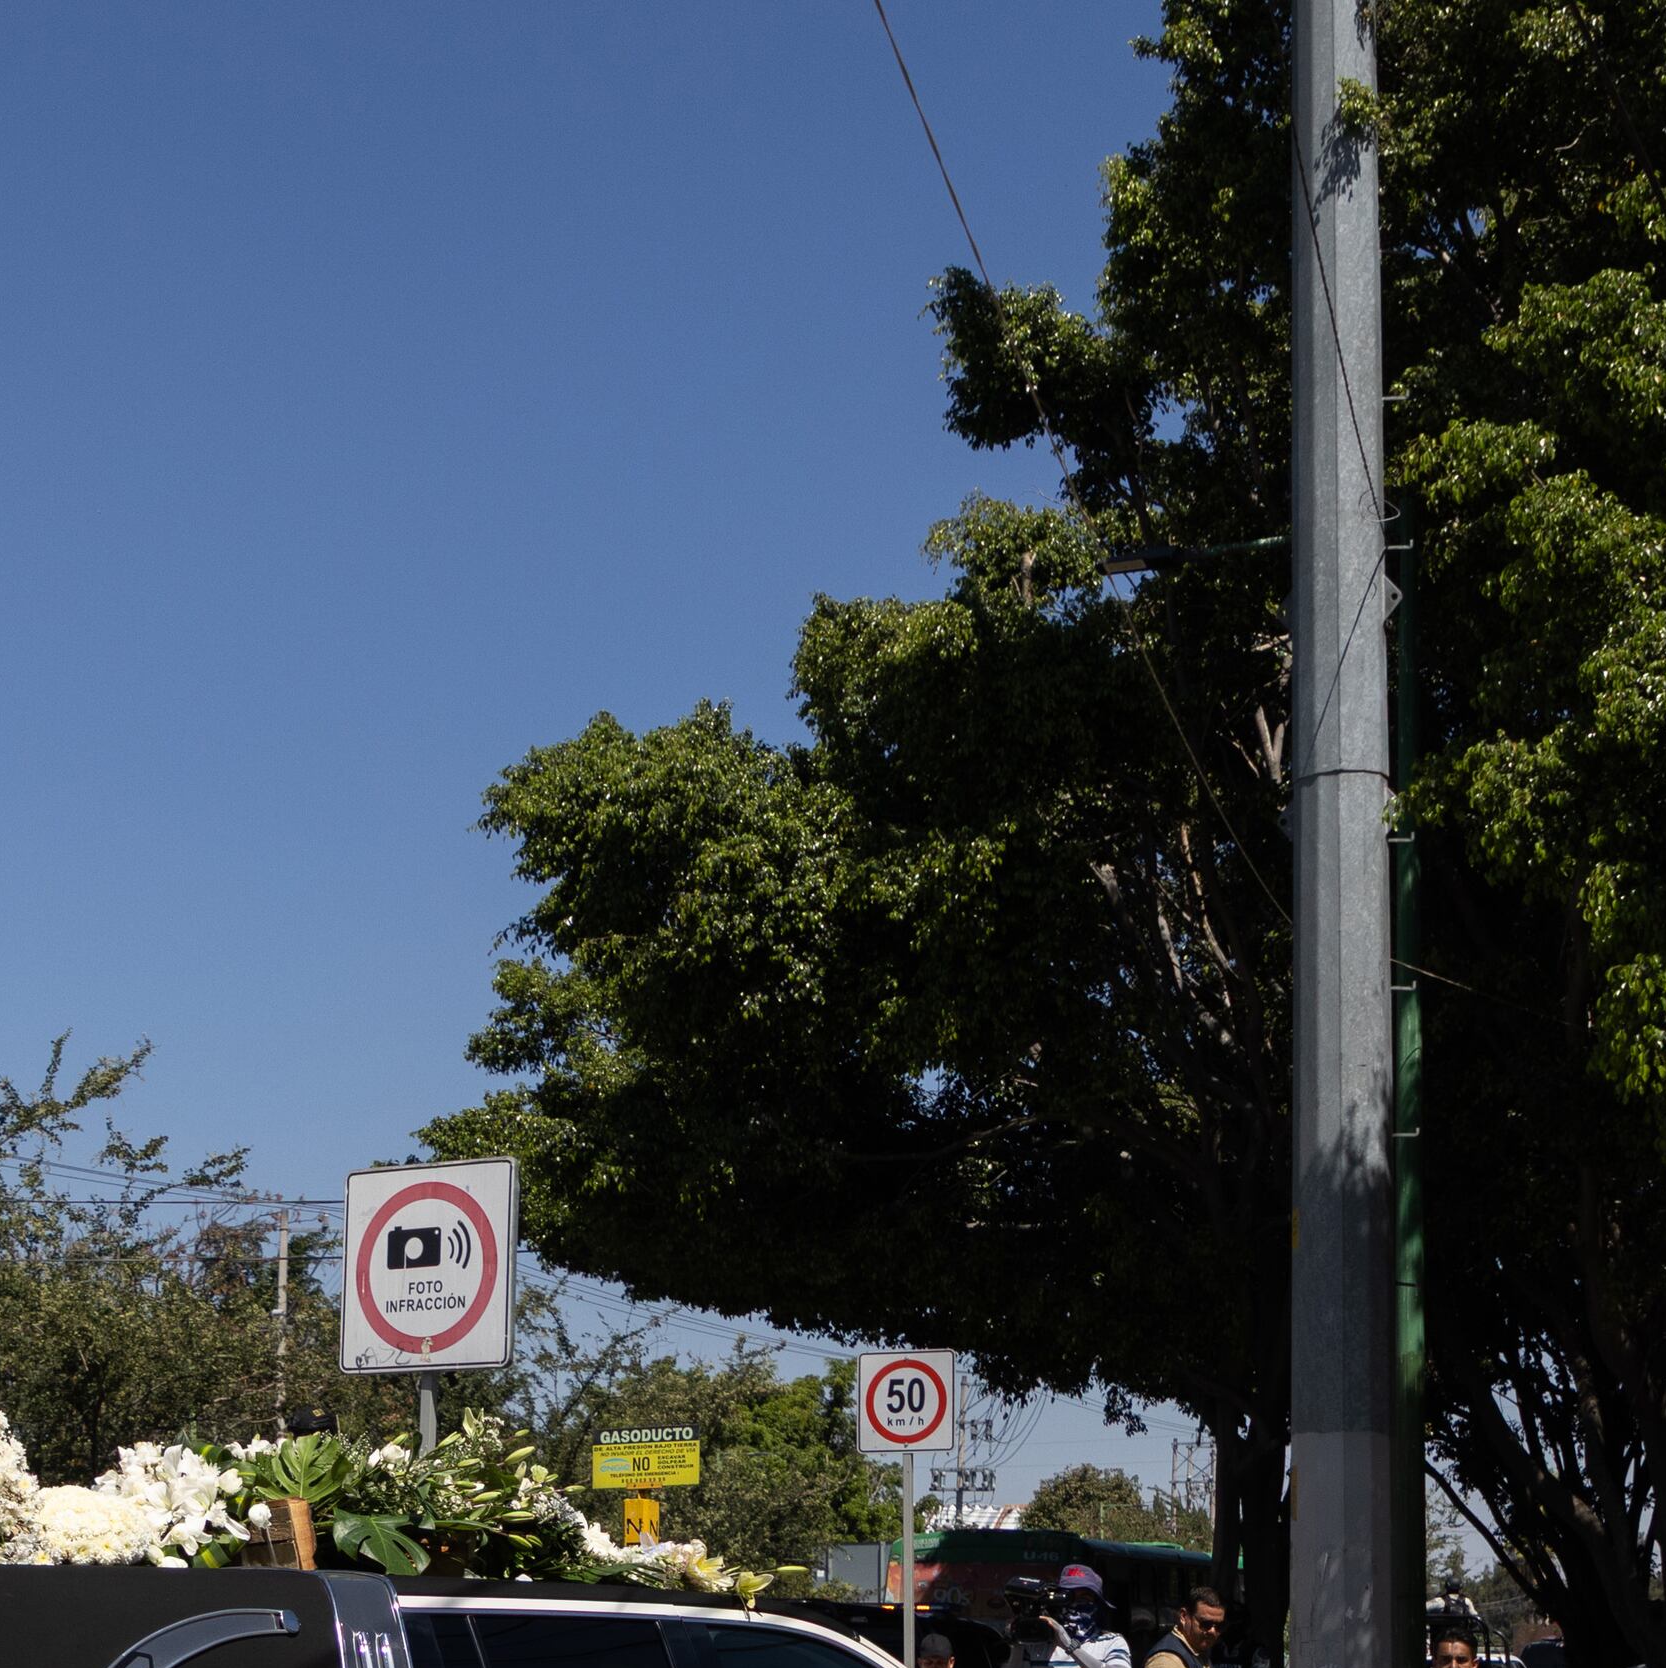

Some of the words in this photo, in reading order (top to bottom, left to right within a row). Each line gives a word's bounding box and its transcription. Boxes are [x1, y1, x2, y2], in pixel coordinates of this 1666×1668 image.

[408, 1280, 443, 1295] FOTO
[386, 1293, 466, 1313] INFRACCIÓN
[886, 1377, 925, 1413] 50
[600, 1427, 693, 1444] GASODUCTO
[632, 1457, 650, 1472] NO
